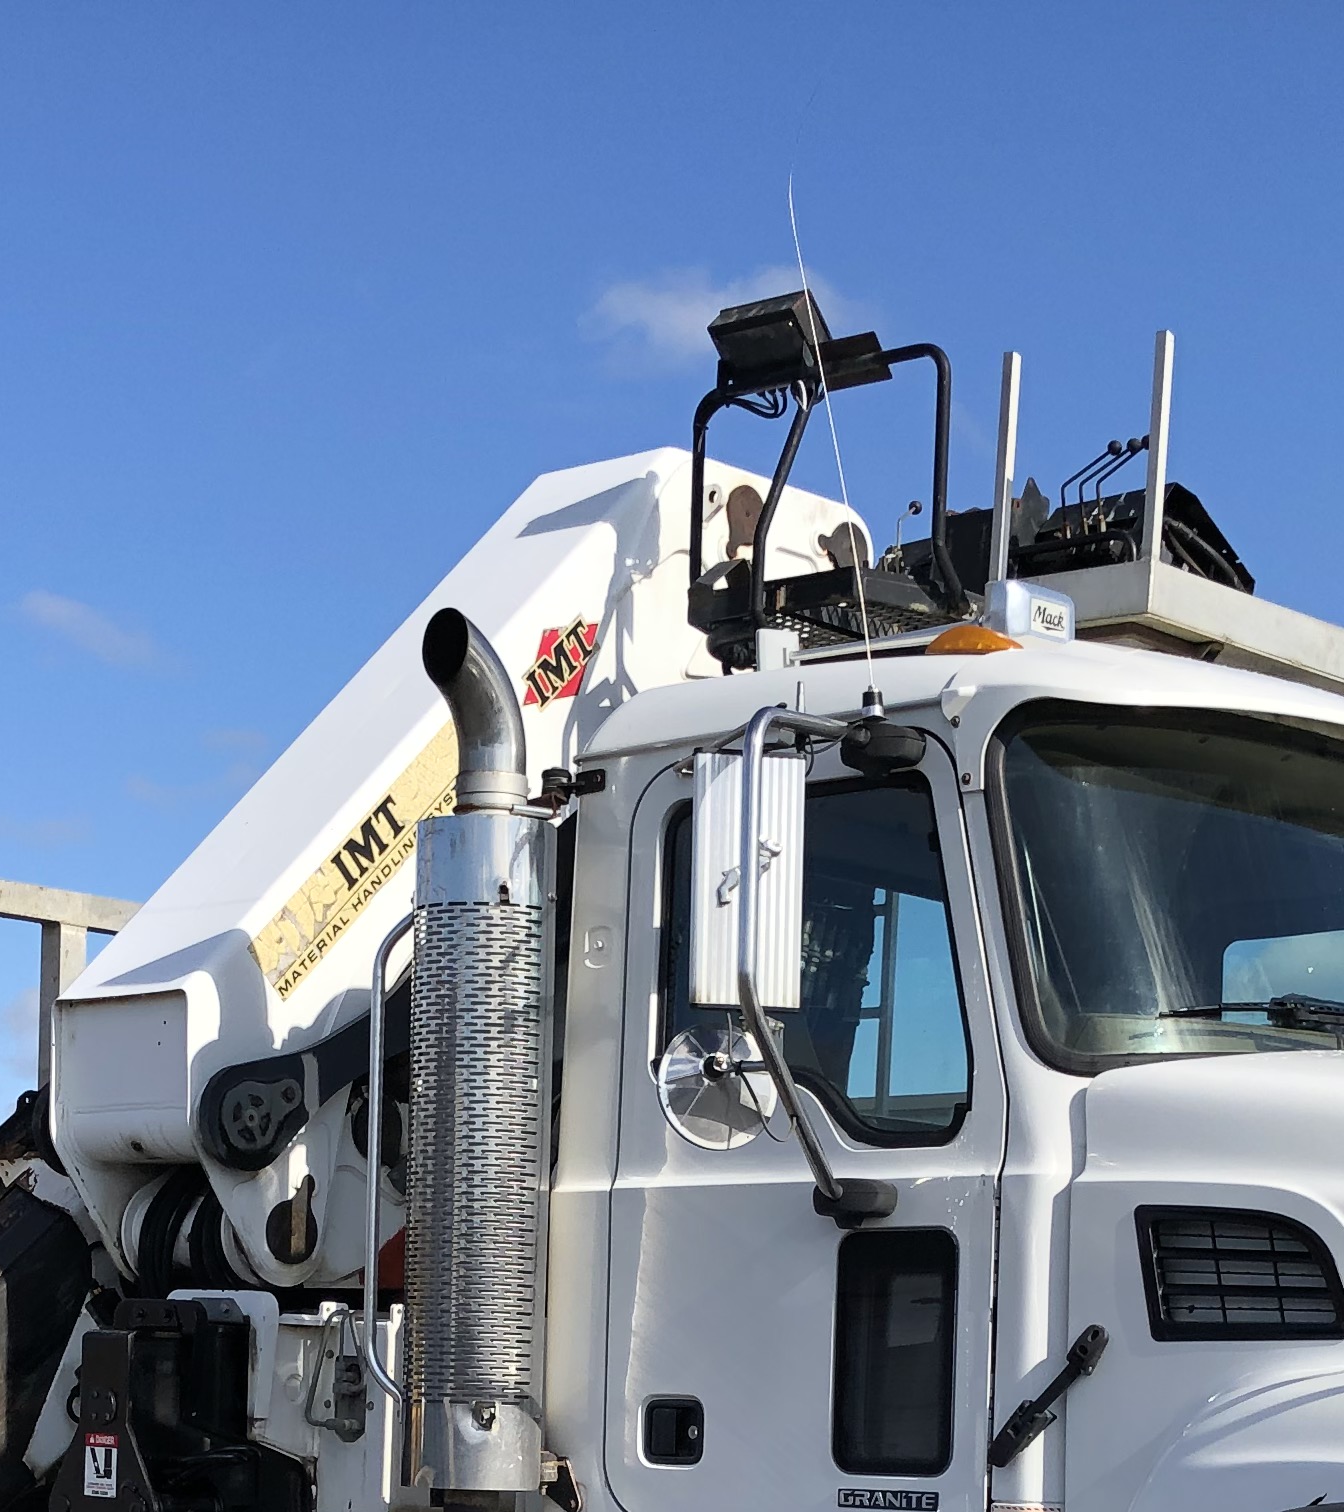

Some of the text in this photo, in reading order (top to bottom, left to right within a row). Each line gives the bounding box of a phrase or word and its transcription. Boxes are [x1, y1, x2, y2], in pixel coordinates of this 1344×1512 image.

[1033, 605, 1065, 629] Mack
[524, 619, 593, 708] IMT
[330, 794, 406, 892] IMT
[277, 916, 350, 998] MATERIAL
